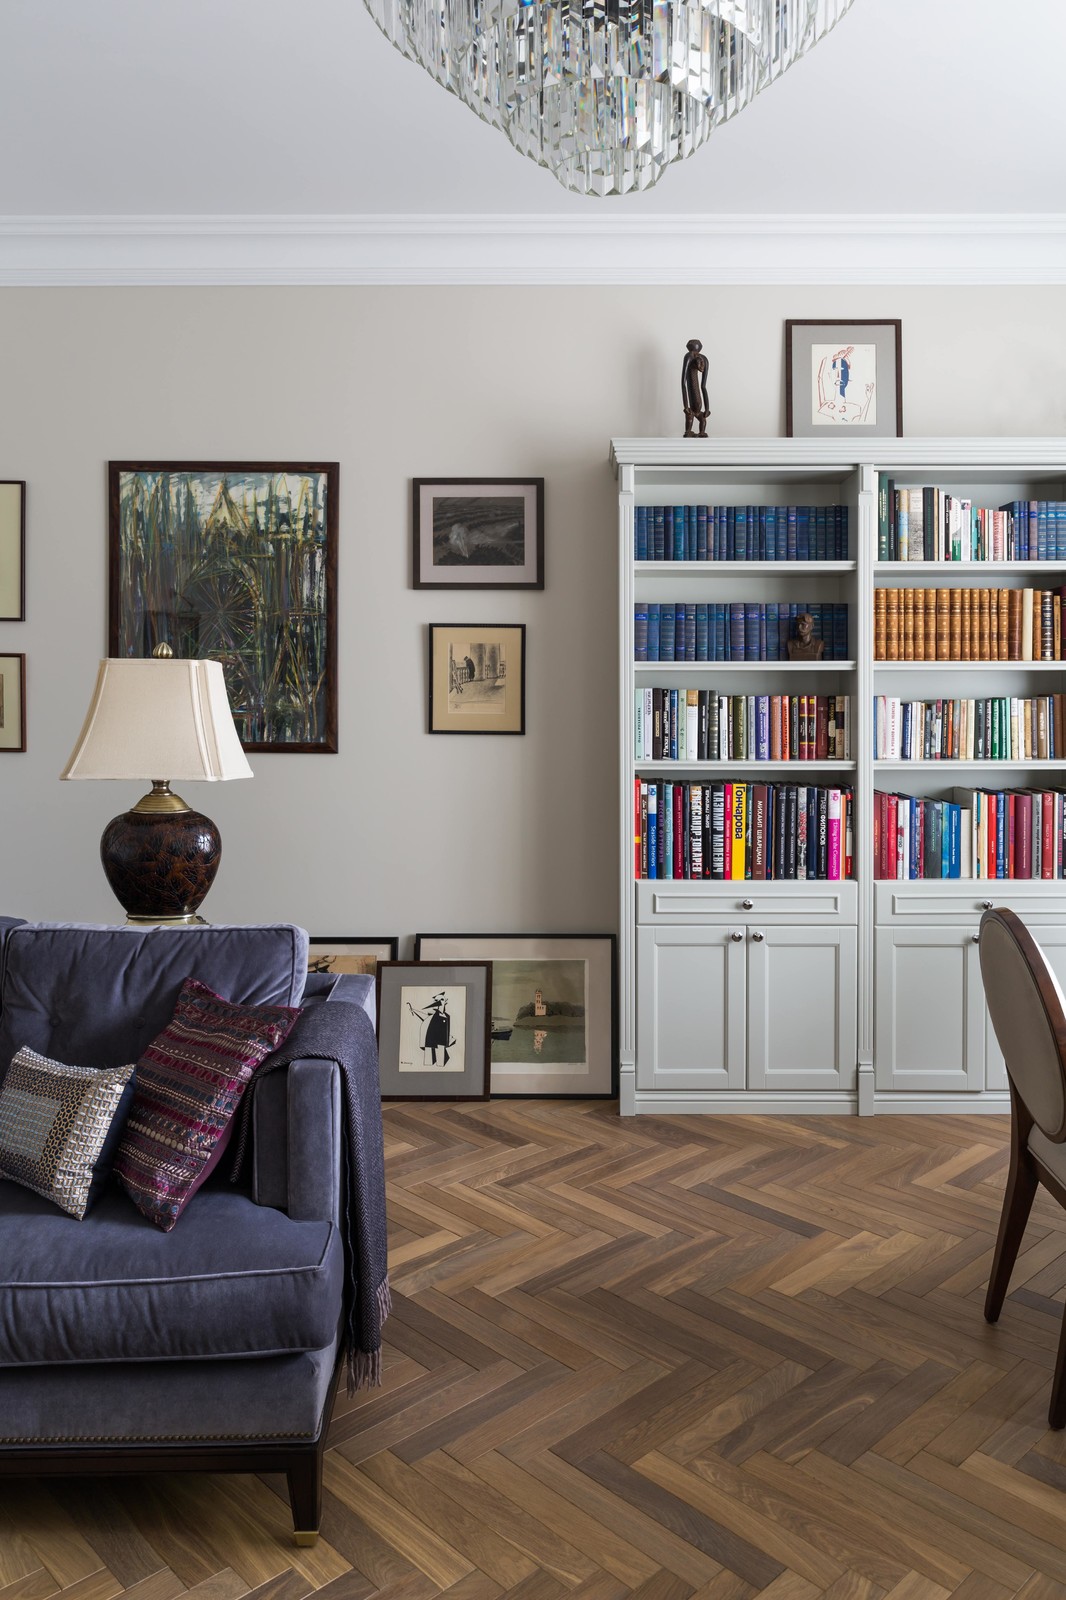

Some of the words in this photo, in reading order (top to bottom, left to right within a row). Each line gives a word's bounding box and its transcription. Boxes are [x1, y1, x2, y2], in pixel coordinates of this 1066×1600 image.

[713, 792, 724, 831] КАЗИМИР
[733, 786, 745, 839] Гончарова
[693, 839, 702, 872] ТОКАРЕВ
[713, 835, 724, 872] МАЛЕВИЧ
